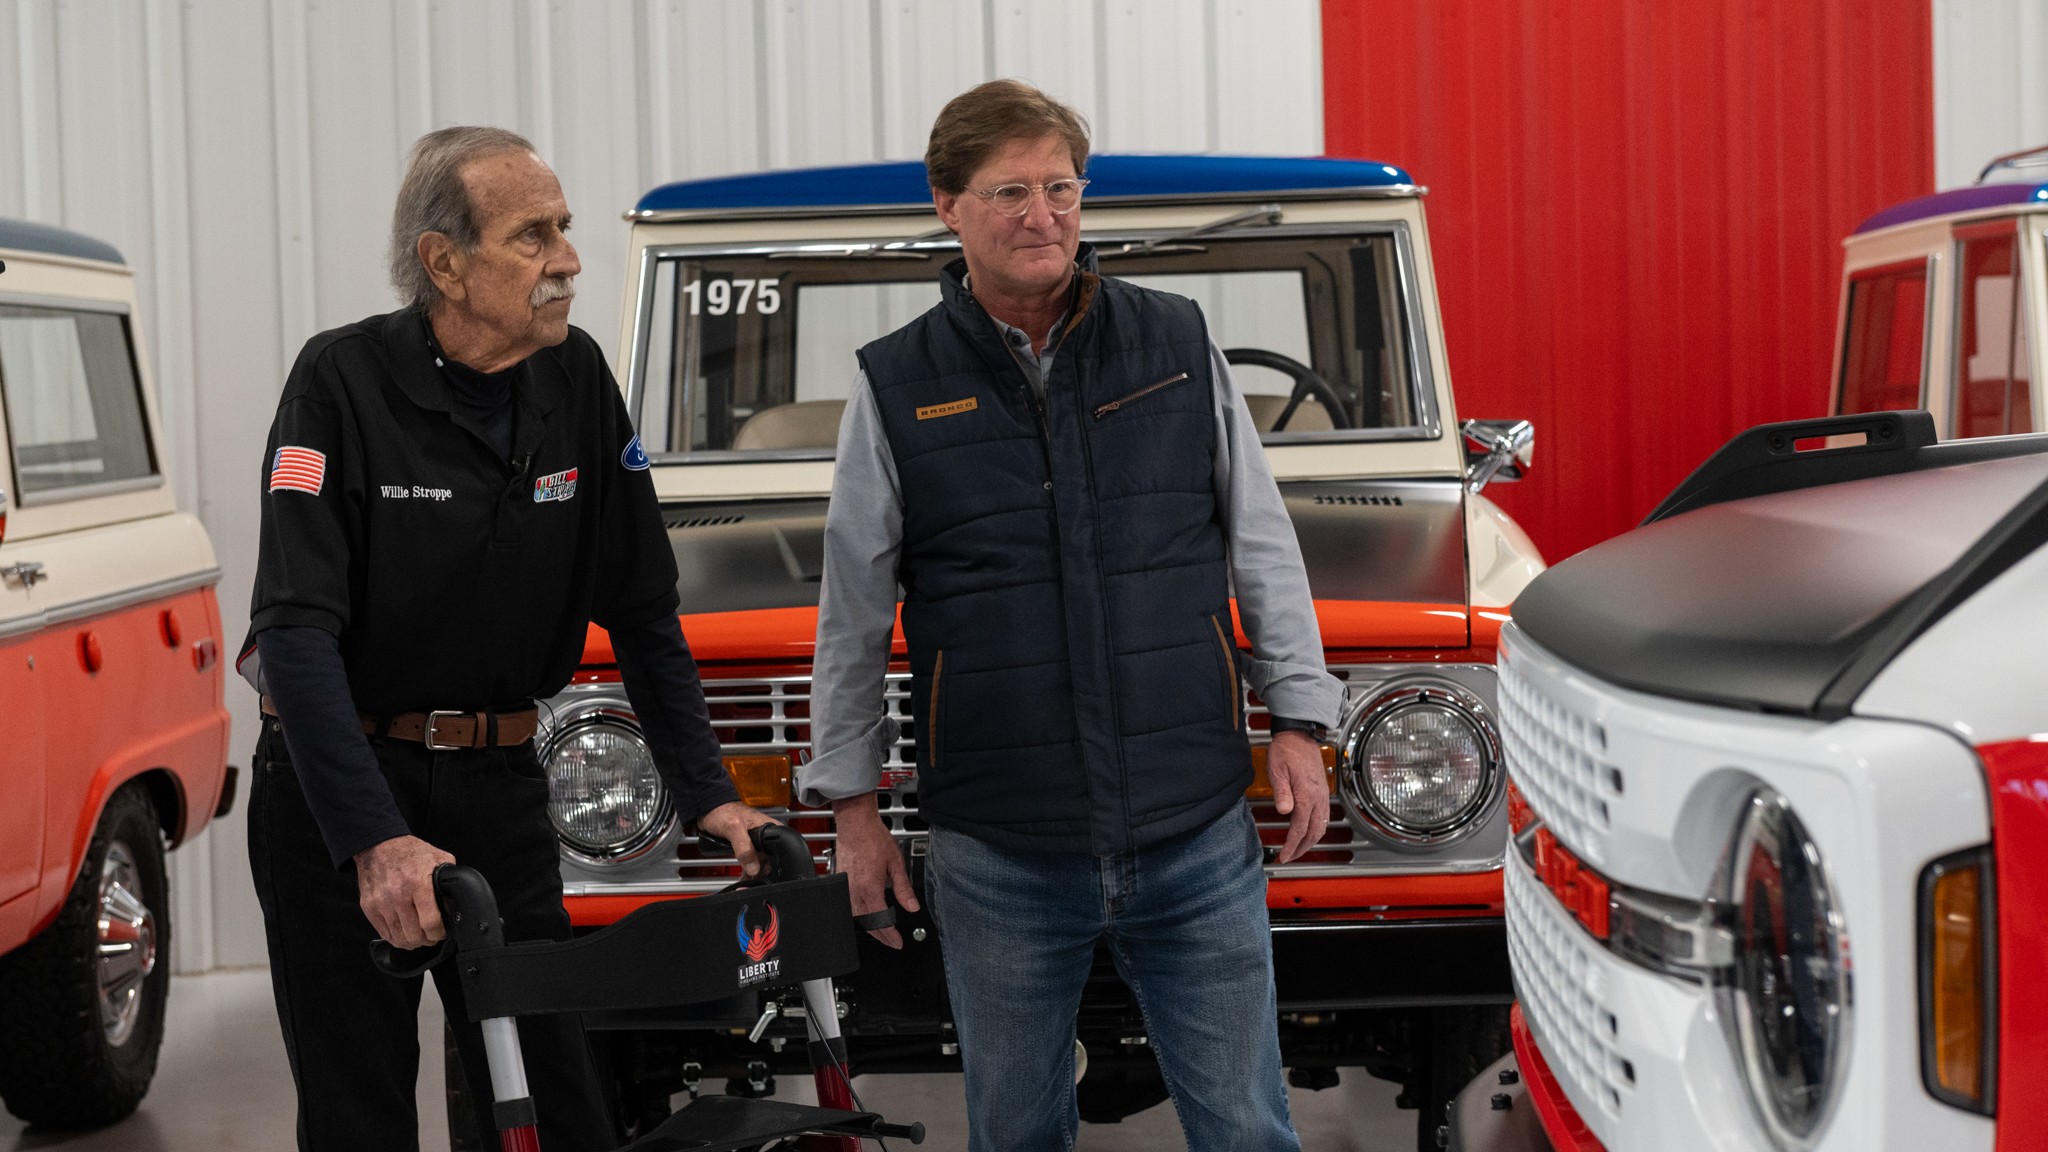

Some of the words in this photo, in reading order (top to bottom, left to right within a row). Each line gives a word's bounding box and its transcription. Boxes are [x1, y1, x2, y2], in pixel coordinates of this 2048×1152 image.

[683, 278, 780, 315] 1975
[921, 402, 973, 416] BRONCO
[549, 473, 566, 487] BILL
[380, 485, 409, 498] Willie
[412, 485, 452, 501] Stroppe
[740, 959, 779, 980] LIBERTY
